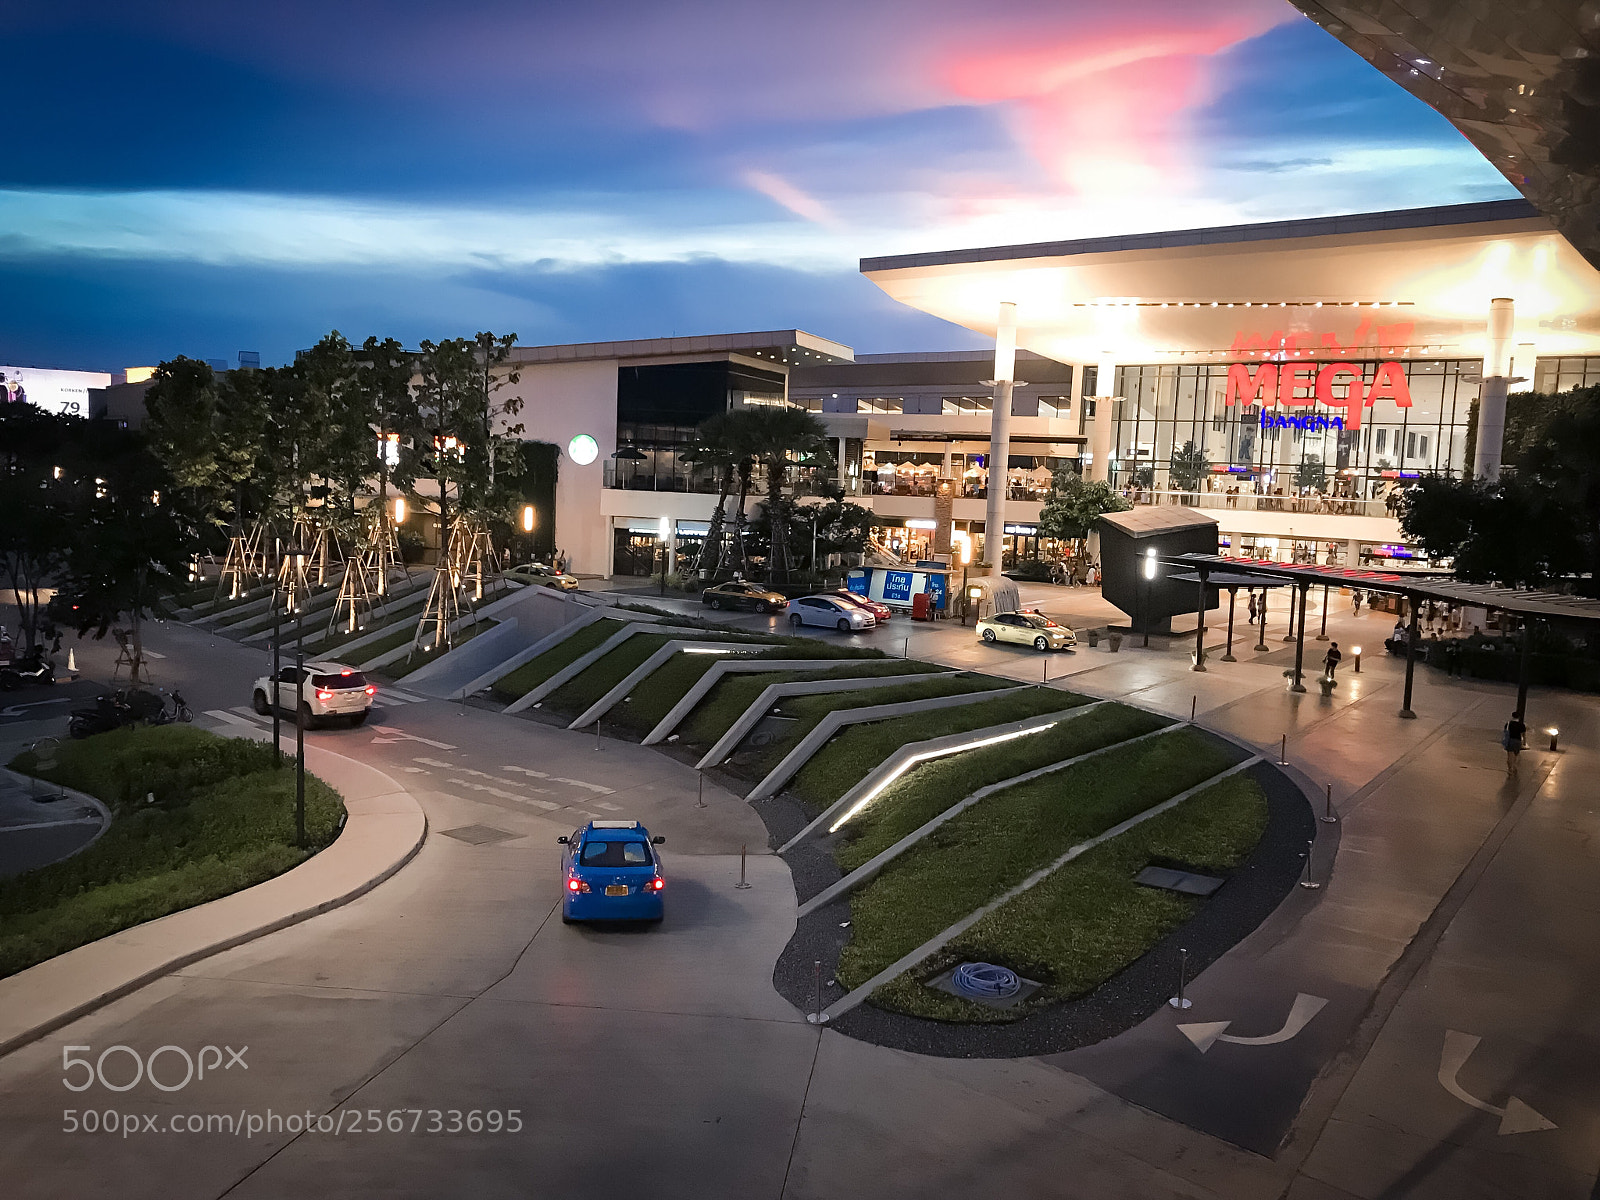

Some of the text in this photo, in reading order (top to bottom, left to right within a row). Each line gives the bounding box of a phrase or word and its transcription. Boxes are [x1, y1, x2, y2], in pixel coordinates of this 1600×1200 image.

[1225, 361, 1413, 431] MEGA
[60, 402, 80, 414] 79
[890, 574, 906, 583] ไทย
[886, 582, 910, 592] ประกัน
